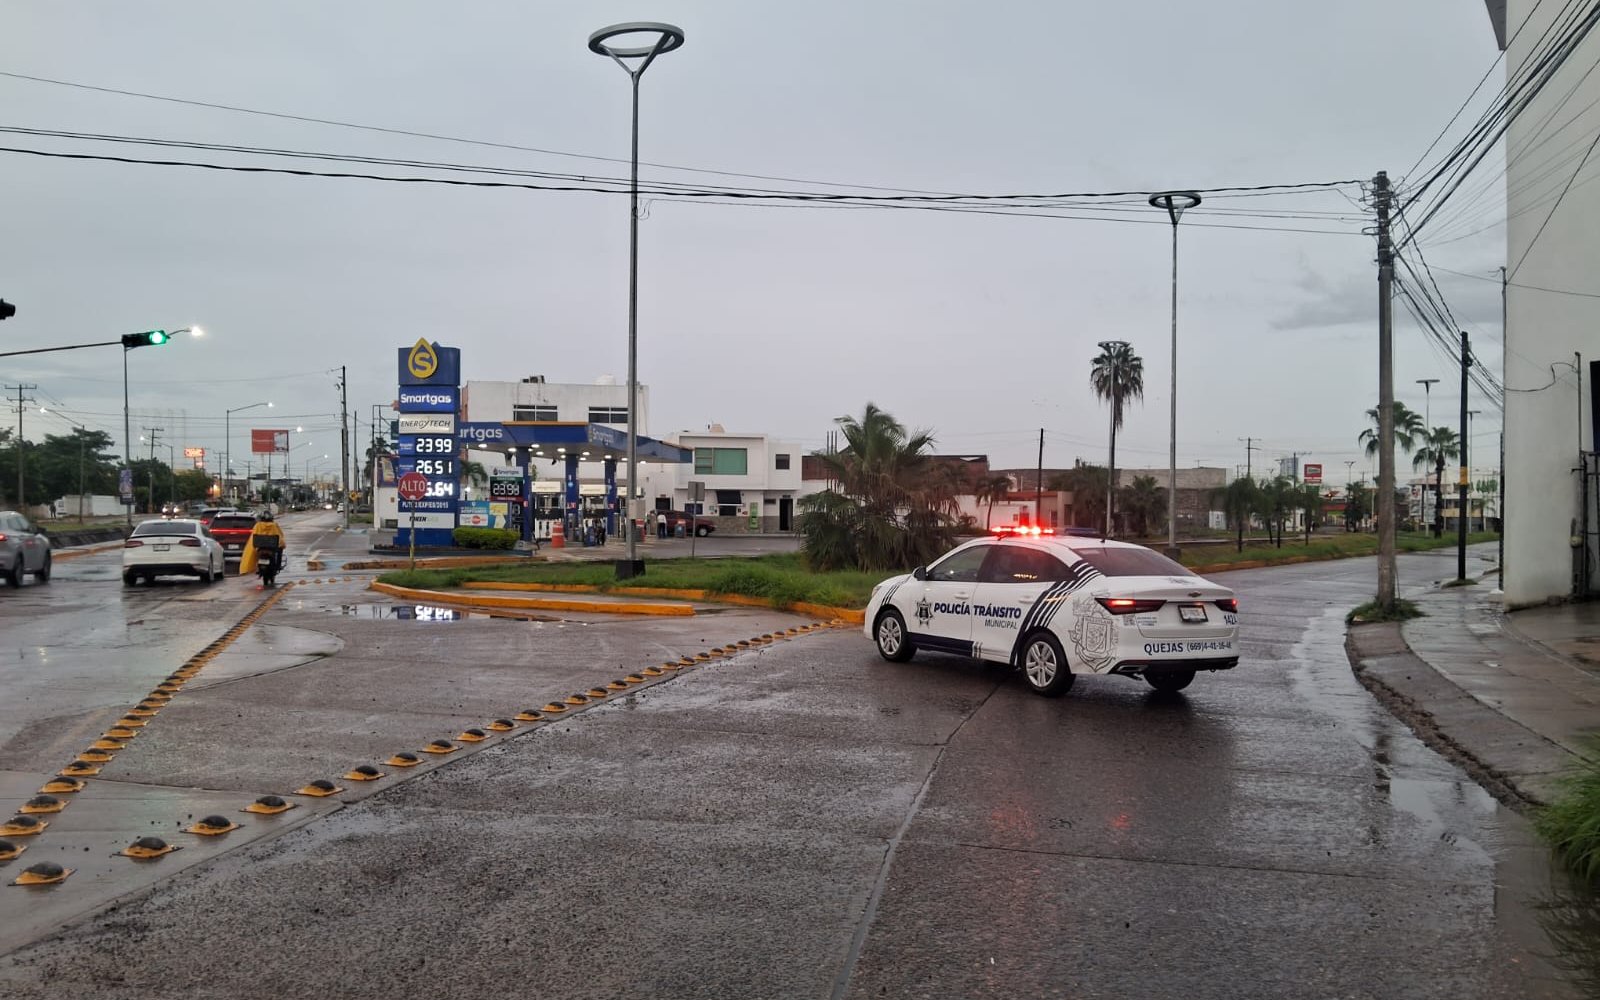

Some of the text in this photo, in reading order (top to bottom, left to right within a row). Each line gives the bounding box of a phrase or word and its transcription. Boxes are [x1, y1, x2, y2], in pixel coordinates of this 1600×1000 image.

[400, 393, 452, 406] Smartgas
[400, 419, 451, 430] ENERGYTECH
[400, 480, 425, 492] ALTO
[934, 602, 1022, 619] POLICÍA TRÁNSITO
[985, 619, 1018, 630] MUNICIPAL
[1144, 642, 1184, 656] QUEJAS
